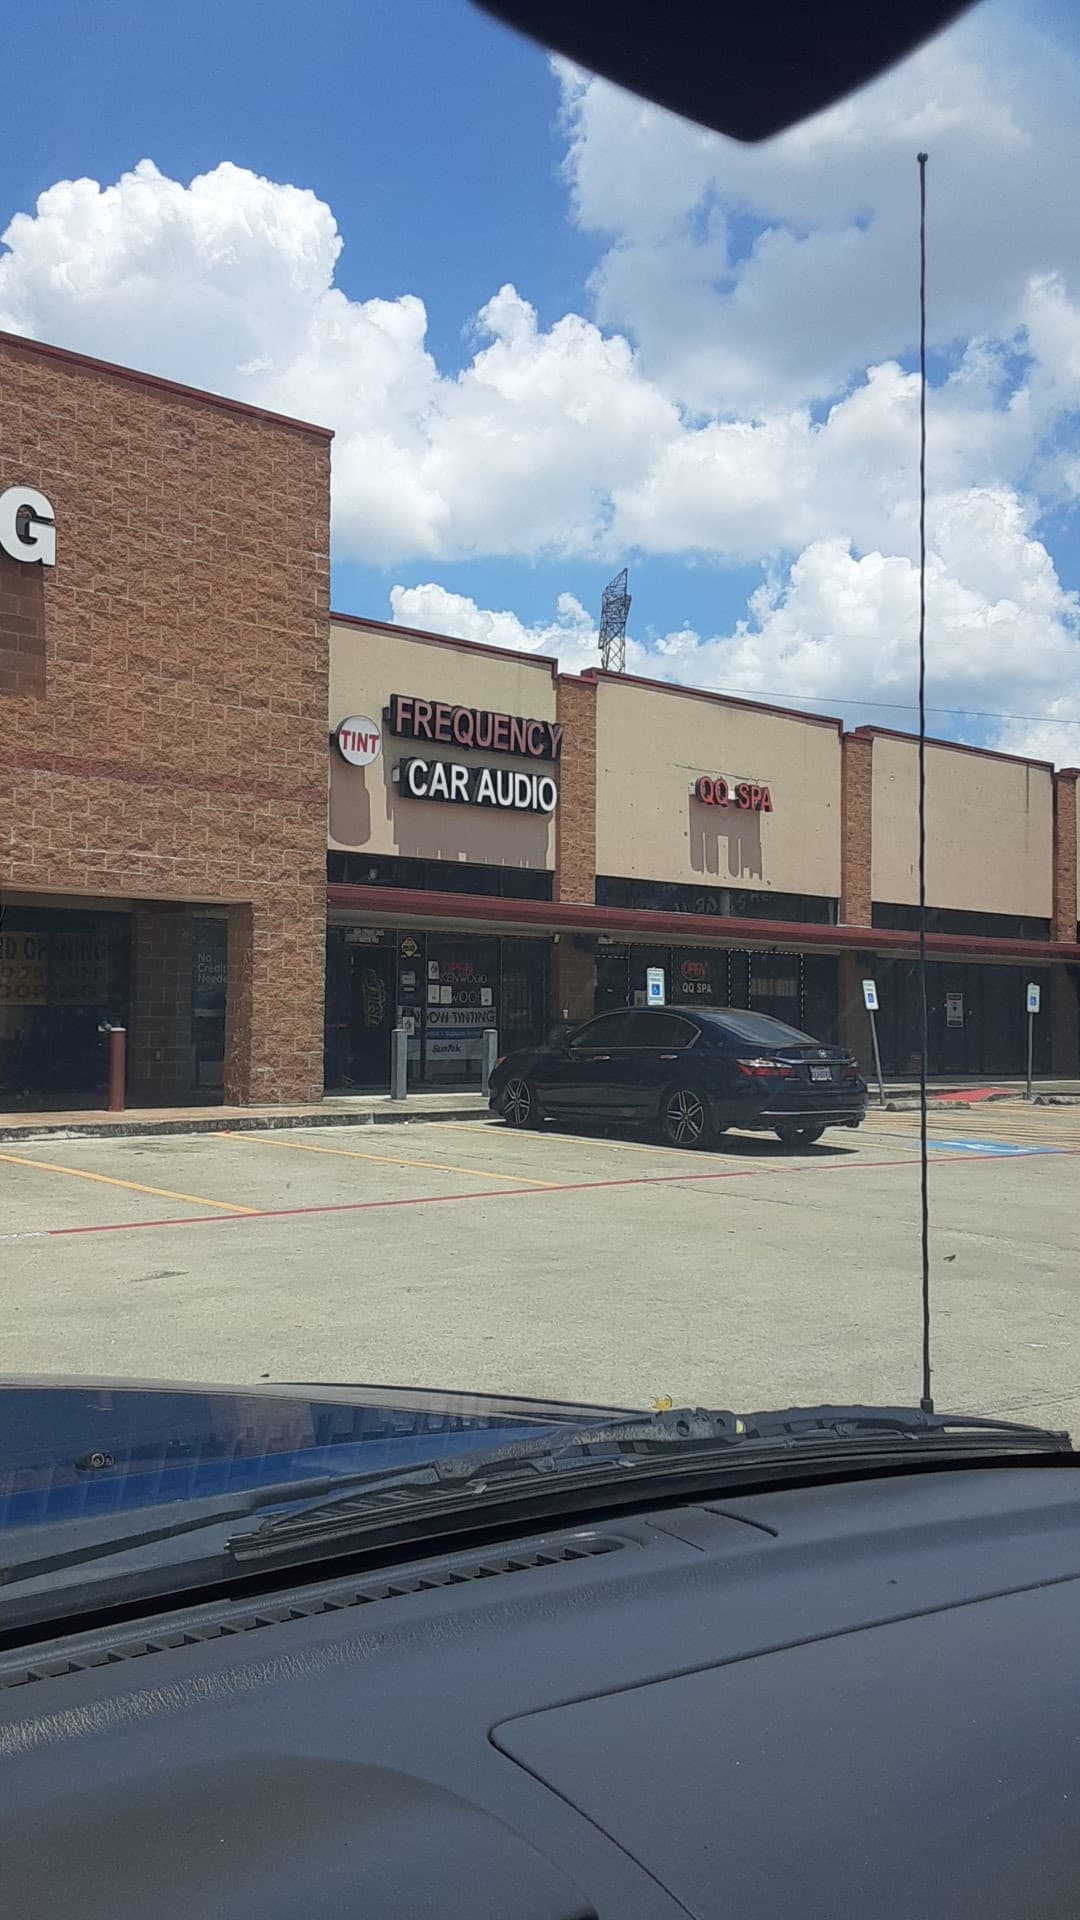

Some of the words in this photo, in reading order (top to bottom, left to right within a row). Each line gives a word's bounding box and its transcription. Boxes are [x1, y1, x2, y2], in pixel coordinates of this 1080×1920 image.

[395, 697, 564, 758] FREQUENCY
[340, 729, 380, 755] TINT
[407, 758, 470, 802] CAR
[477, 767, 558, 812] AUDIO
[698, 775, 730, 807] QQ
[736, 783, 774, 812] SPA
[198, 952, 212, 962] No
[198, 962, 226, 974] Credit
[682, 982, 695, 994] QQ
[696, 982, 713, 995] SPA
[451, 1009, 496, 1025] TINTING
